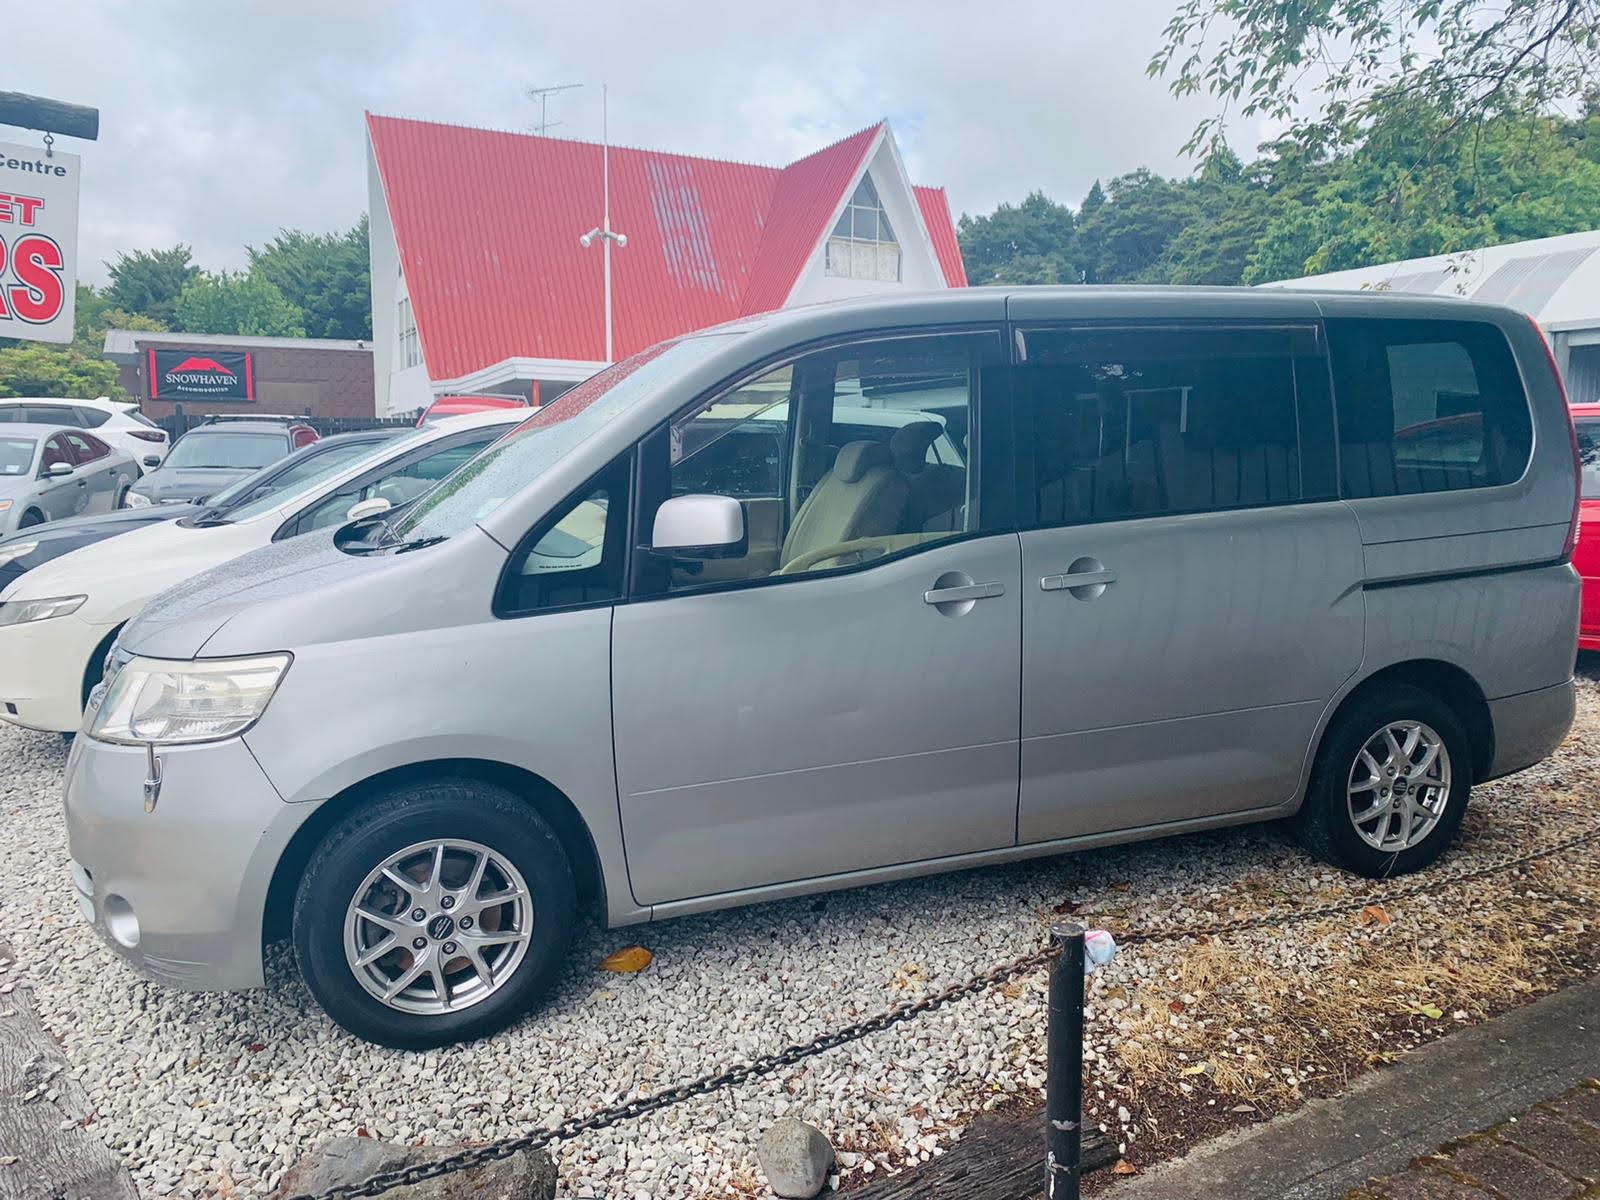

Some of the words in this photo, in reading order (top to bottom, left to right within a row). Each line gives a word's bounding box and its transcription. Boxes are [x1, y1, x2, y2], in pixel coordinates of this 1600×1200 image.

[0, 233, 64, 325] S
[165, 374, 238, 385] SNOWHAVEN
[177, 385, 229, 393] Accommodation
